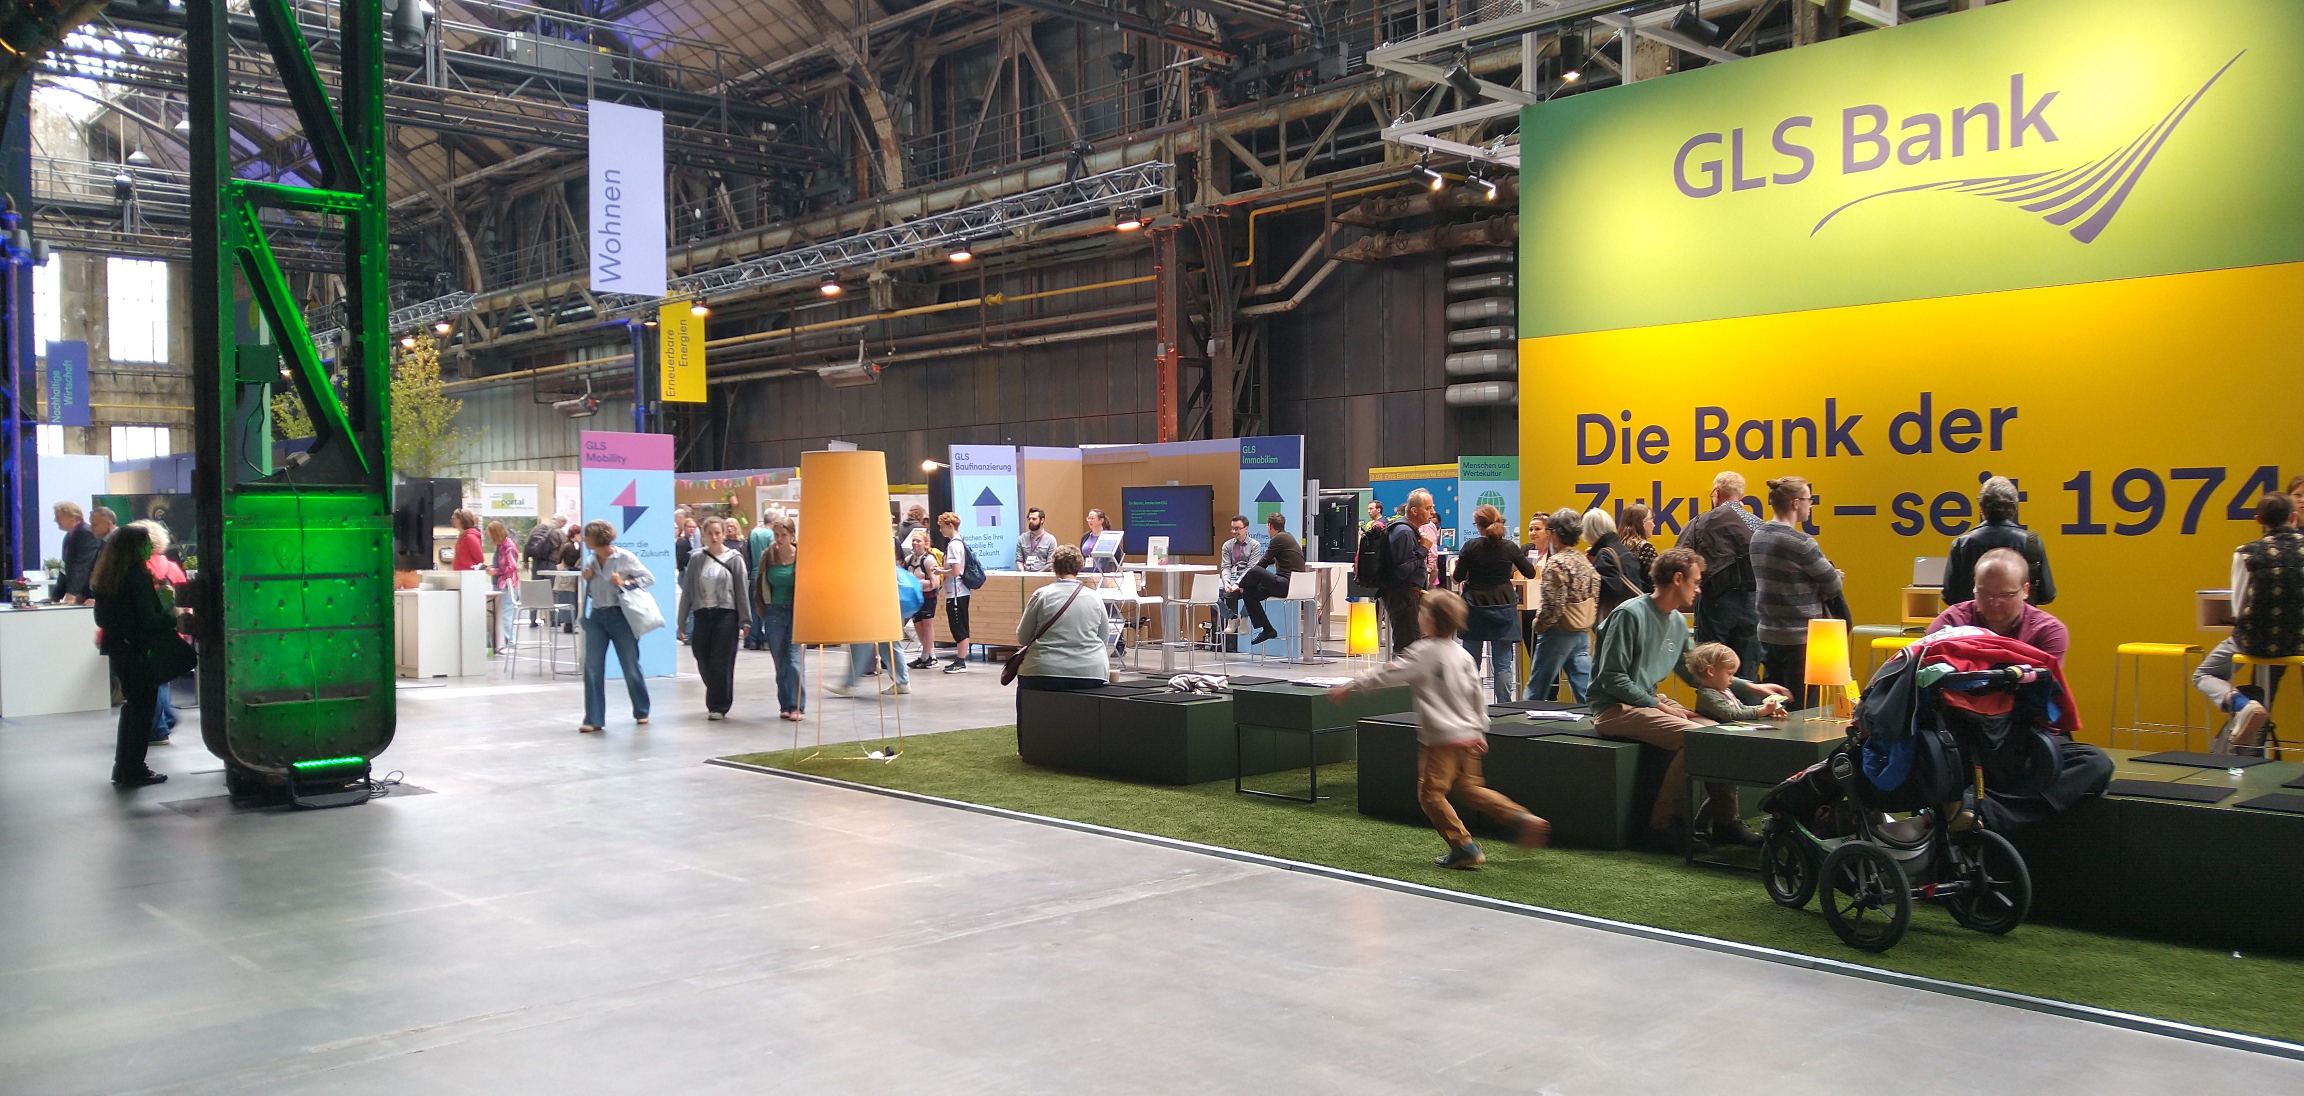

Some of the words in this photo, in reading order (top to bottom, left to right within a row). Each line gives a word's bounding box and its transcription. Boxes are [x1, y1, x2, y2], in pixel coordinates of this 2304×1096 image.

[1673, 115, 1815, 198] GLS
[1841, 73, 2061, 175] Bank
[598, 169, 622, 283] Wohnen
[678, 319, 690, 367] Energien
[666, 329, 676, 397] Erneuerbare
[51, 369, 62, 423] Nachhaltige
[63, 360, 73, 406] Wirtschaft
[1576, 409, 1670, 466] Die
[1694, 397, 1864, 462] Bank
[1888, 391, 2018, 455] der
[586, 440, 607, 451] GLS
[586, 453, 627, 465] Mobility
[954, 452, 970, 461] GLS
[1242, 445, 1256, 454] GLS
[1242, 455, 1279, 464] Immobilien
[955, 462, 1012, 472] Baufinanzierung
[1462, 461, 1497, 469] Menschen
[1498, 461, 1510, 469] und
[1462, 470, 1501, 478] Wertekultur
[2060, 465, 2280, 537] 1974
